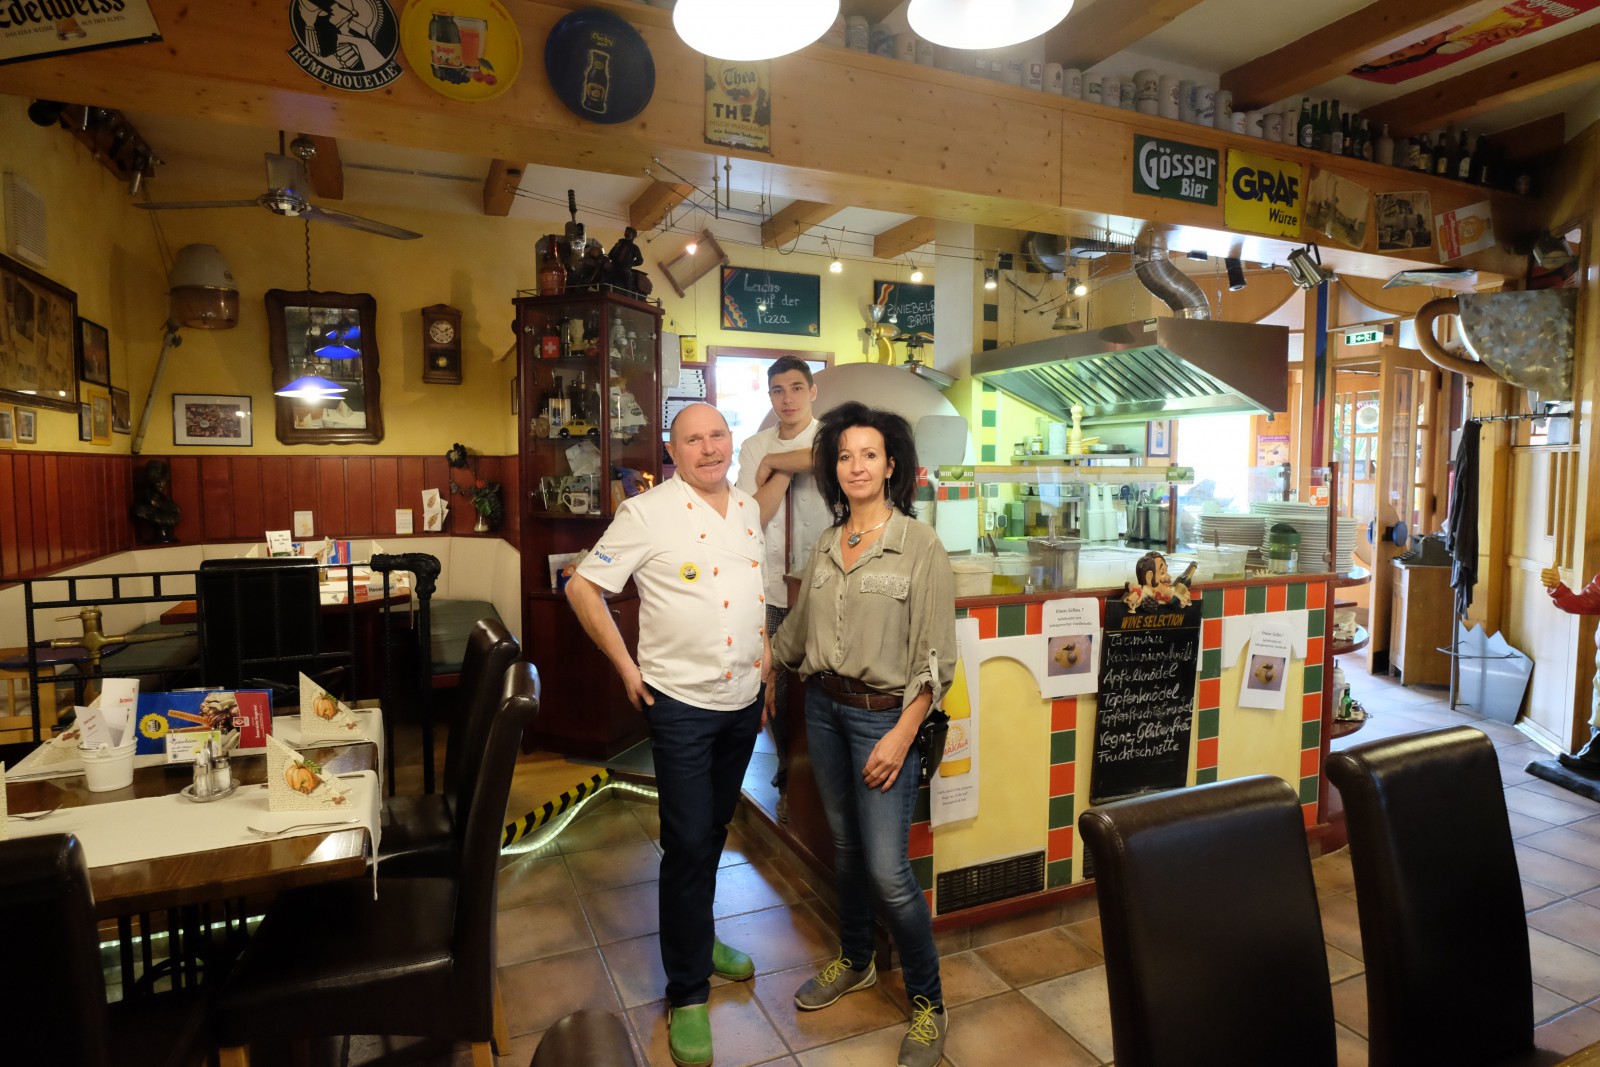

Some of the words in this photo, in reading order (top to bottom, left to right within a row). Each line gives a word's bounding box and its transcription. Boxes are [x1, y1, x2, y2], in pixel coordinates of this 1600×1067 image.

[1139, 141, 1216, 190] Gösser
[1180, 177, 1209, 199] Bier
[1232, 167, 1299, 208] GRAF
[1269, 208, 1298, 226] Würze
[743, 272, 781, 293] Lachs
[781, 297, 800, 308] der
[757, 308, 790, 325] Pizza
[1121, 615, 1142, 629] WINE
[1143, 613, 1185, 628] SELECTION
[1103, 662, 1179, 689] Apfelknödel
[1103, 683, 1180, 709] Topfenknödel
[1097, 736, 1179, 763] Fruchtschnitte
